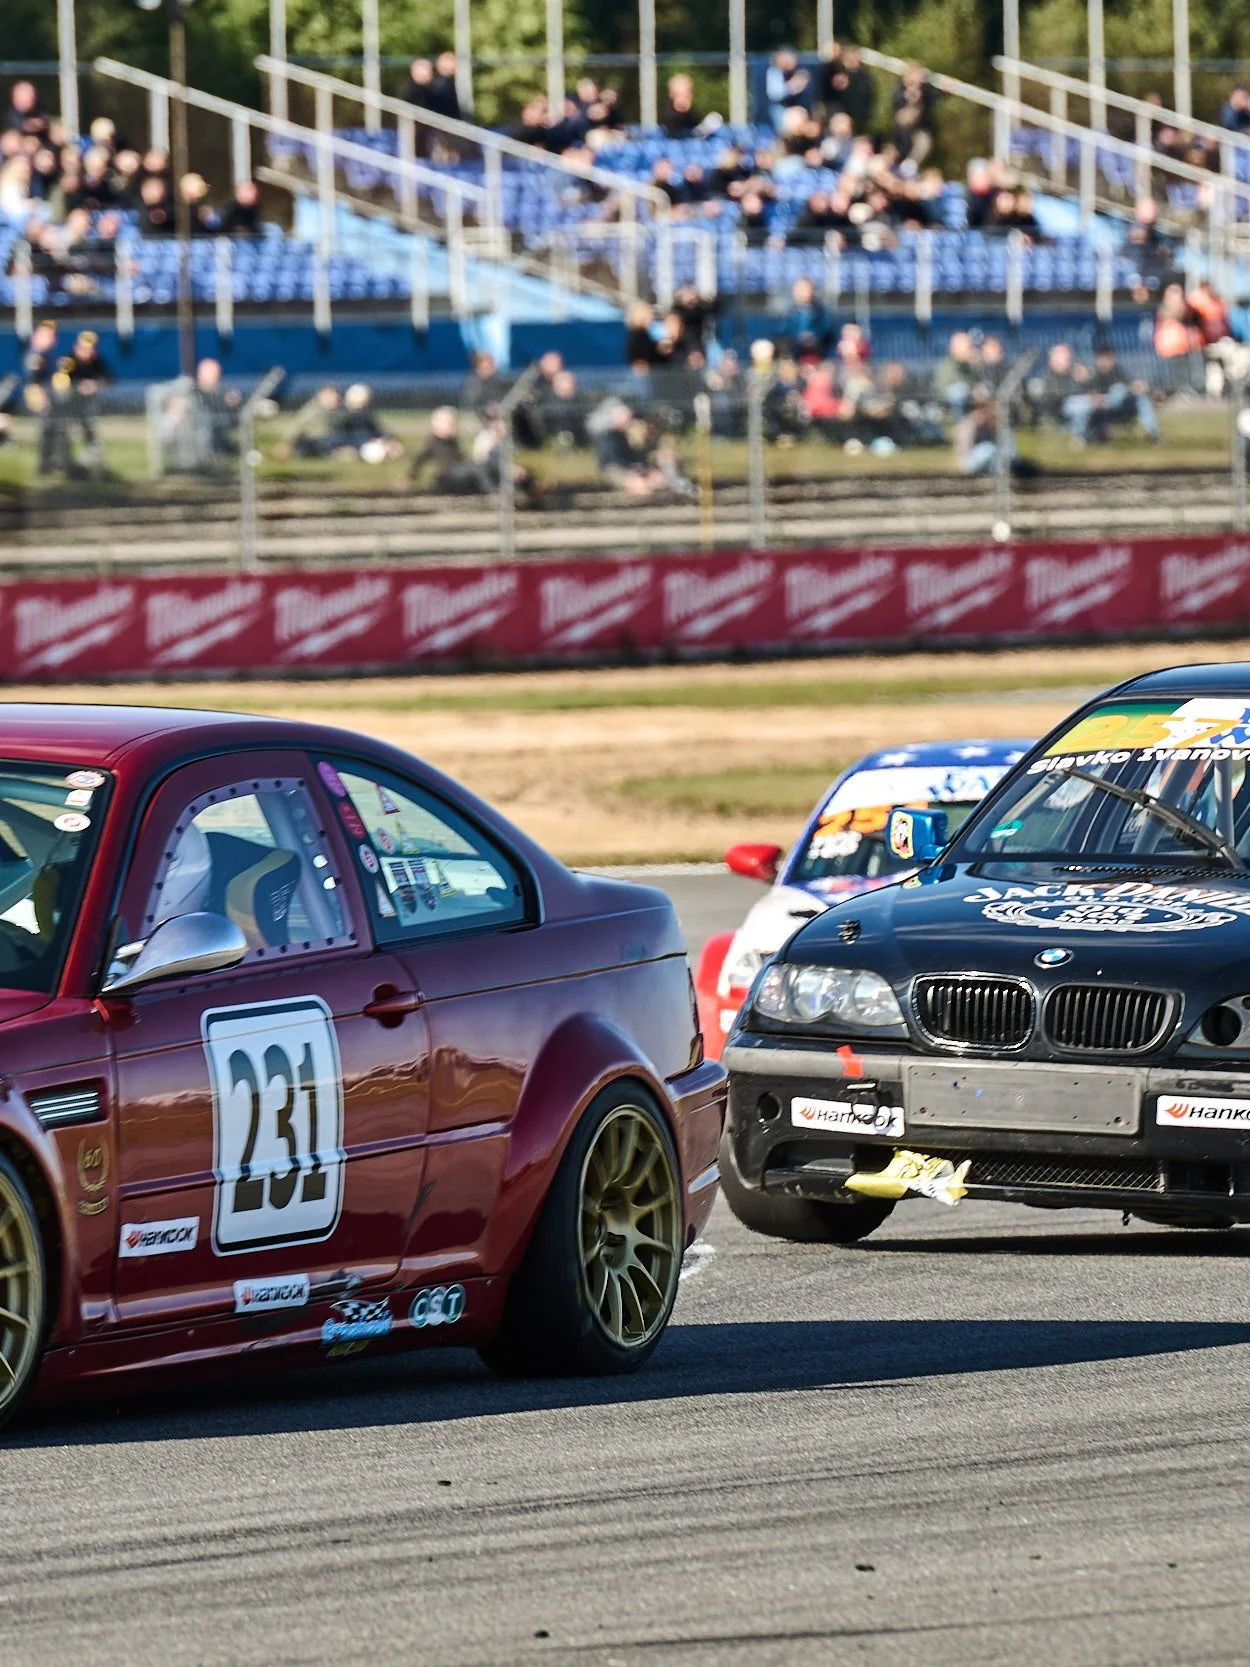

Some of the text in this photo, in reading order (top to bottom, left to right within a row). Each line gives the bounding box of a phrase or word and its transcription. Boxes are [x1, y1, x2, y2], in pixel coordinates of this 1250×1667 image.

[1063, 714, 1242, 749] 257
[1026, 750, 1131, 776] Slavko
[963, 882, 1096, 903] JACK
[228, 1042, 327, 1213] 231
